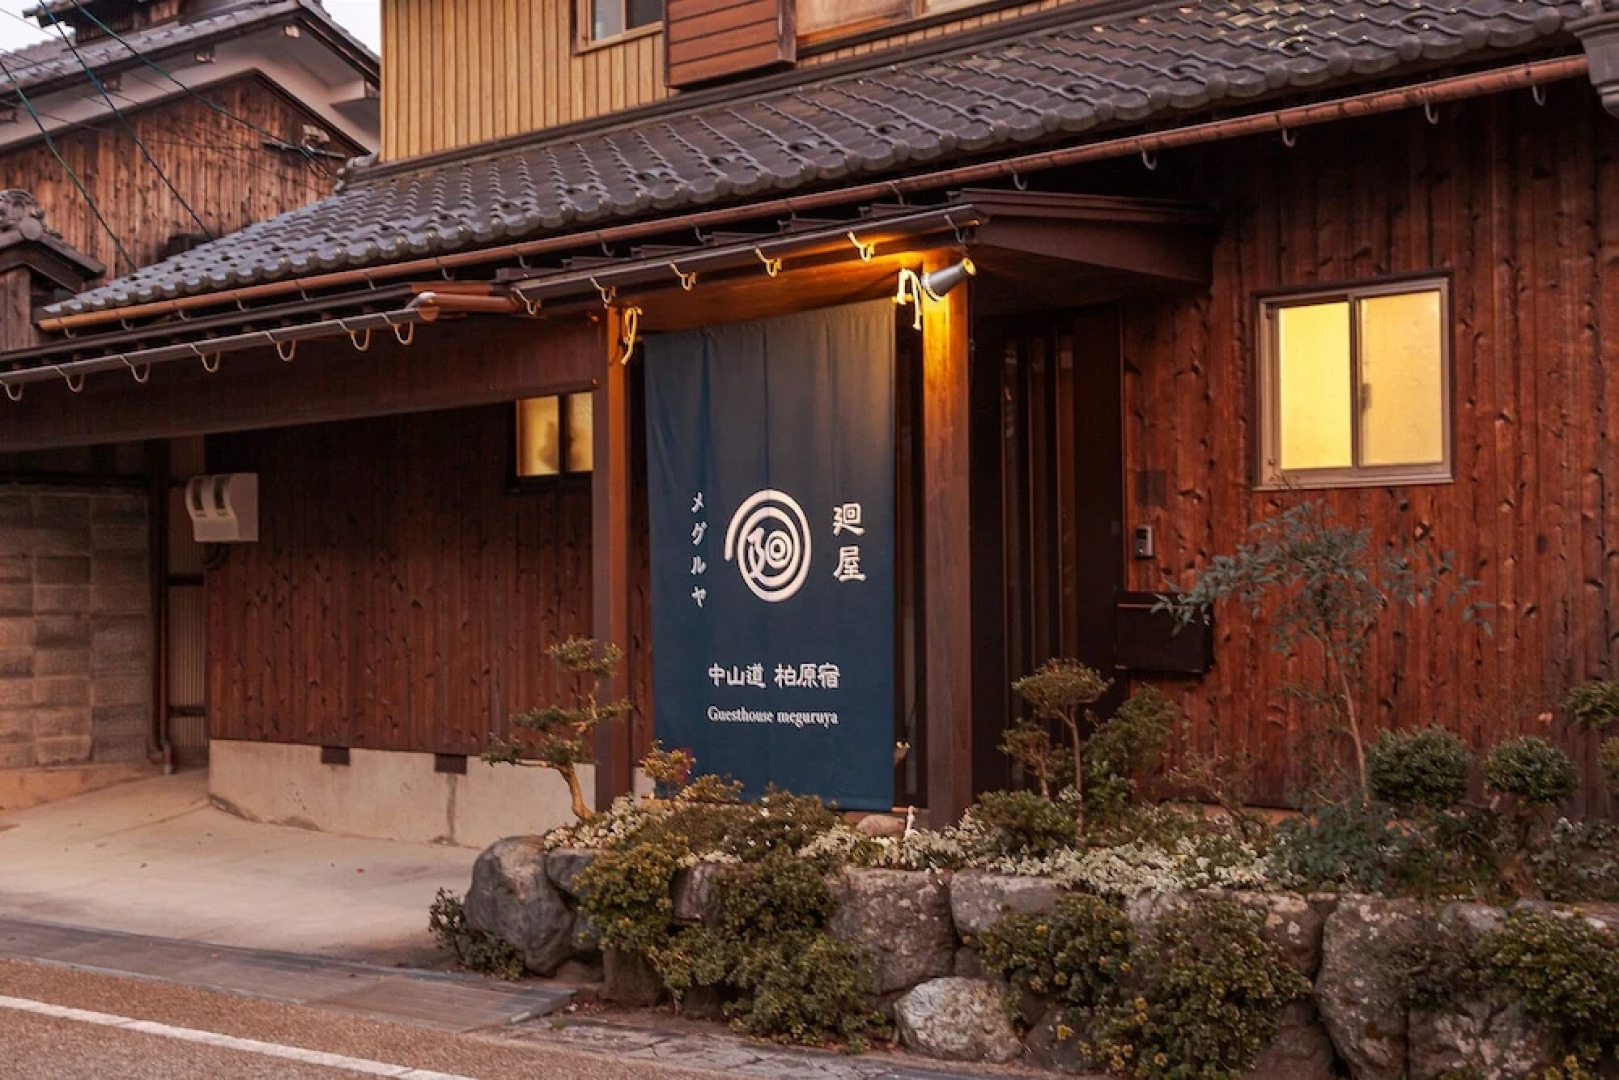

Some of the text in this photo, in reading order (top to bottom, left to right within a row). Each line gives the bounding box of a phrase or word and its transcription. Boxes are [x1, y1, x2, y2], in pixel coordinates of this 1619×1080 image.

[691, 492, 707, 607] メグルヤ
[833, 502, 866, 582] 廻屋
[708, 662, 841, 689] 中山道 柏原宿
[707, 706, 839, 728] Guesthouse meguruya
